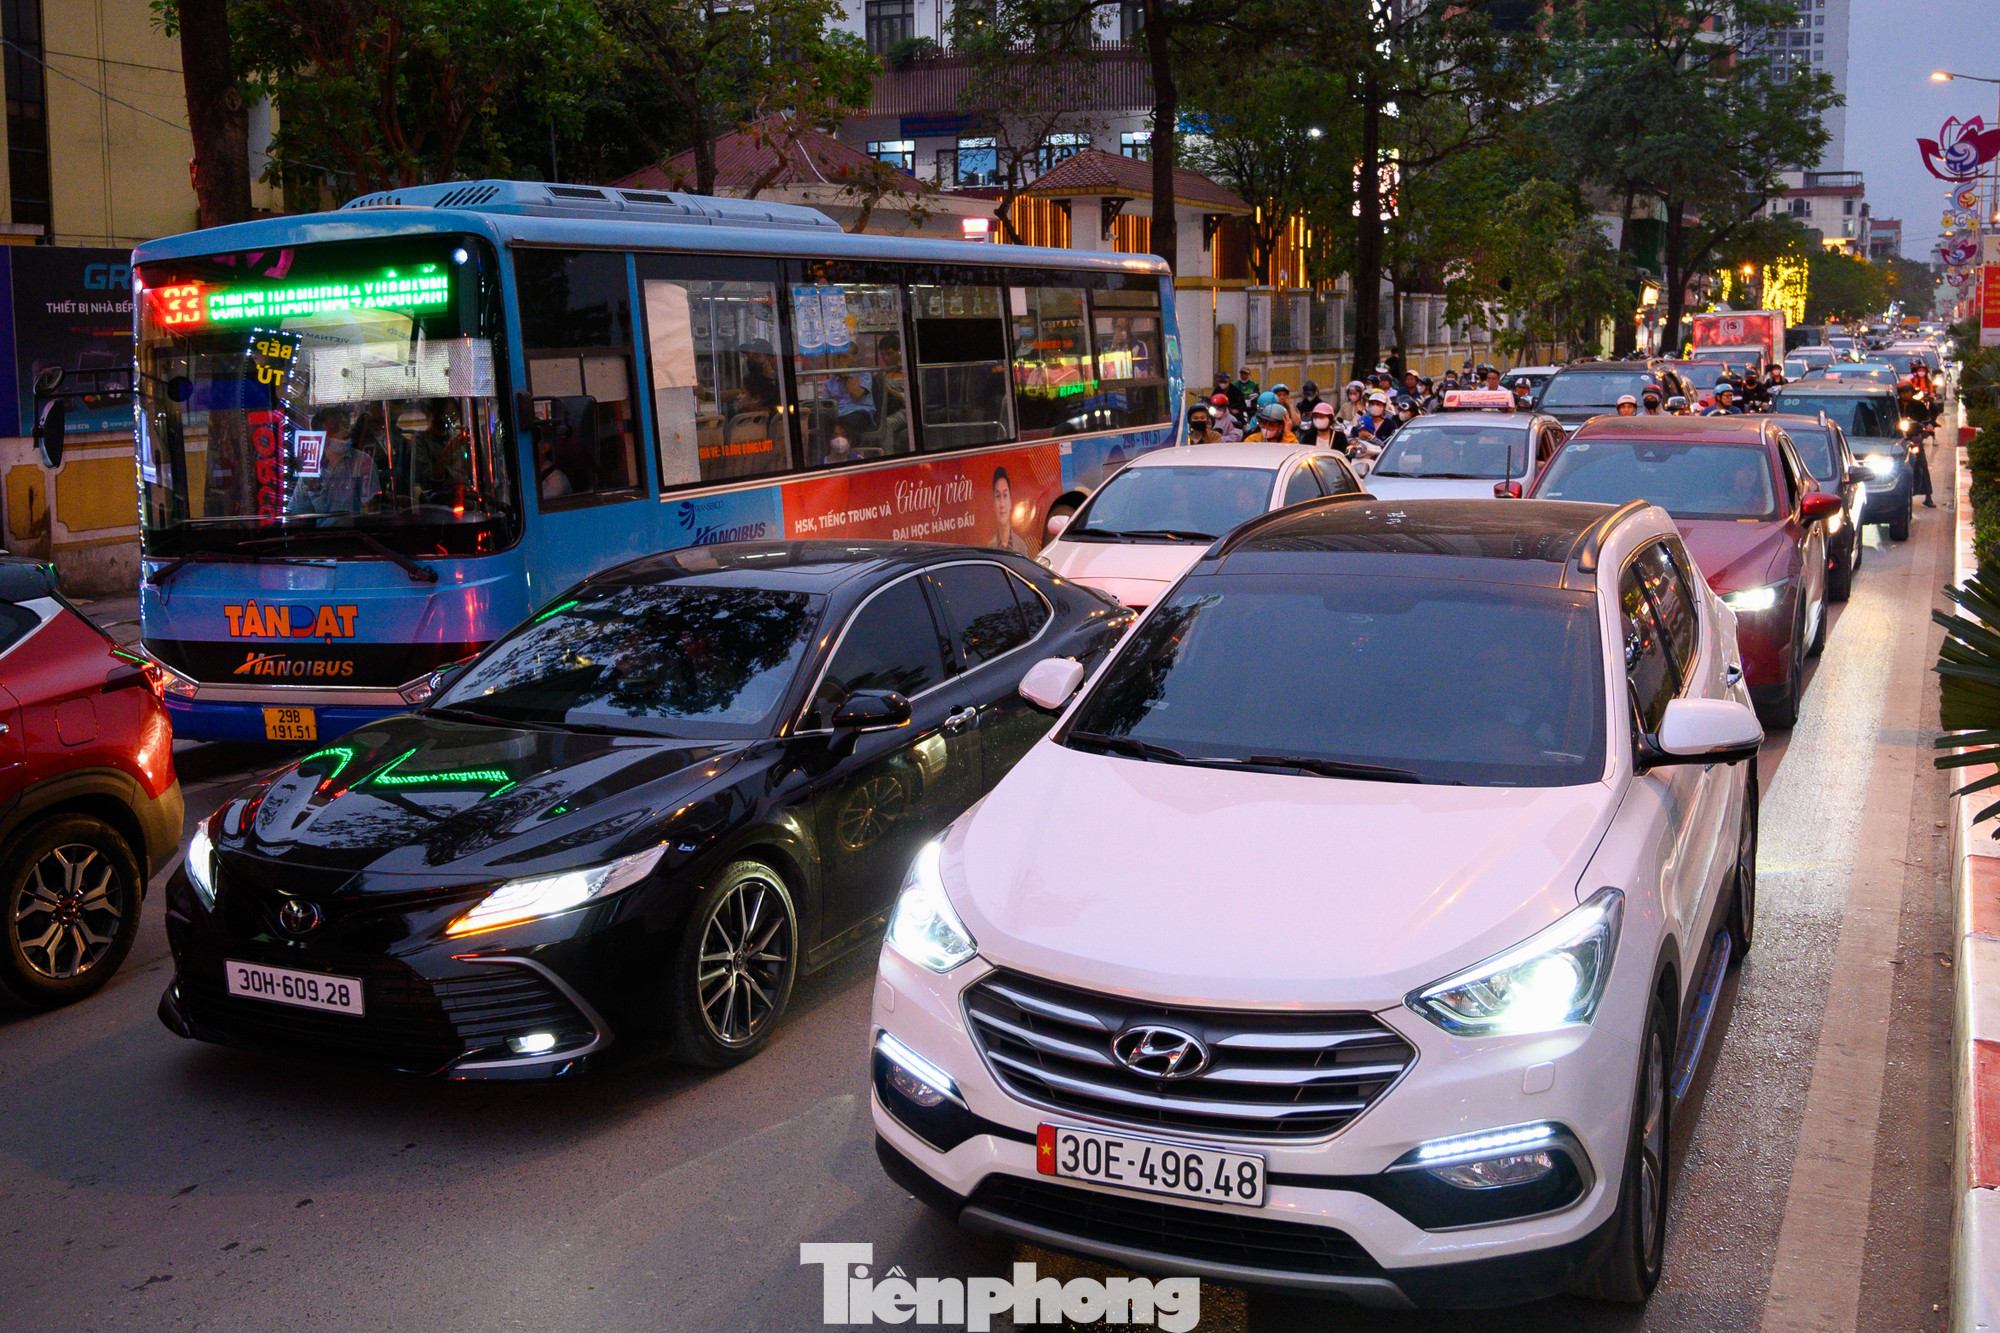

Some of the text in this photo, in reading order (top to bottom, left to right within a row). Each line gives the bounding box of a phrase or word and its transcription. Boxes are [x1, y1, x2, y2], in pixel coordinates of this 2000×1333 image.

[46, 299, 133, 315] THIẾT BỊ NHÀ BẾP
[163, 286, 200, 324] 33
[894, 474, 973, 517] Giảng viên
[795, 500, 893, 533] HSK, TIẾNG TRUNG VÀ
[910, 522, 930, 540] HỌC
[931, 517, 956, 534] HÀNG
[233, 652, 354, 677] HANOIBUS
[278, 709, 301, 724] 29B
[272, 724, 312, 739] 191.51
[238, 968, 351, 1007] 30H-609.28
[1060, 1133, 1258, 1199] 30E-496.48
